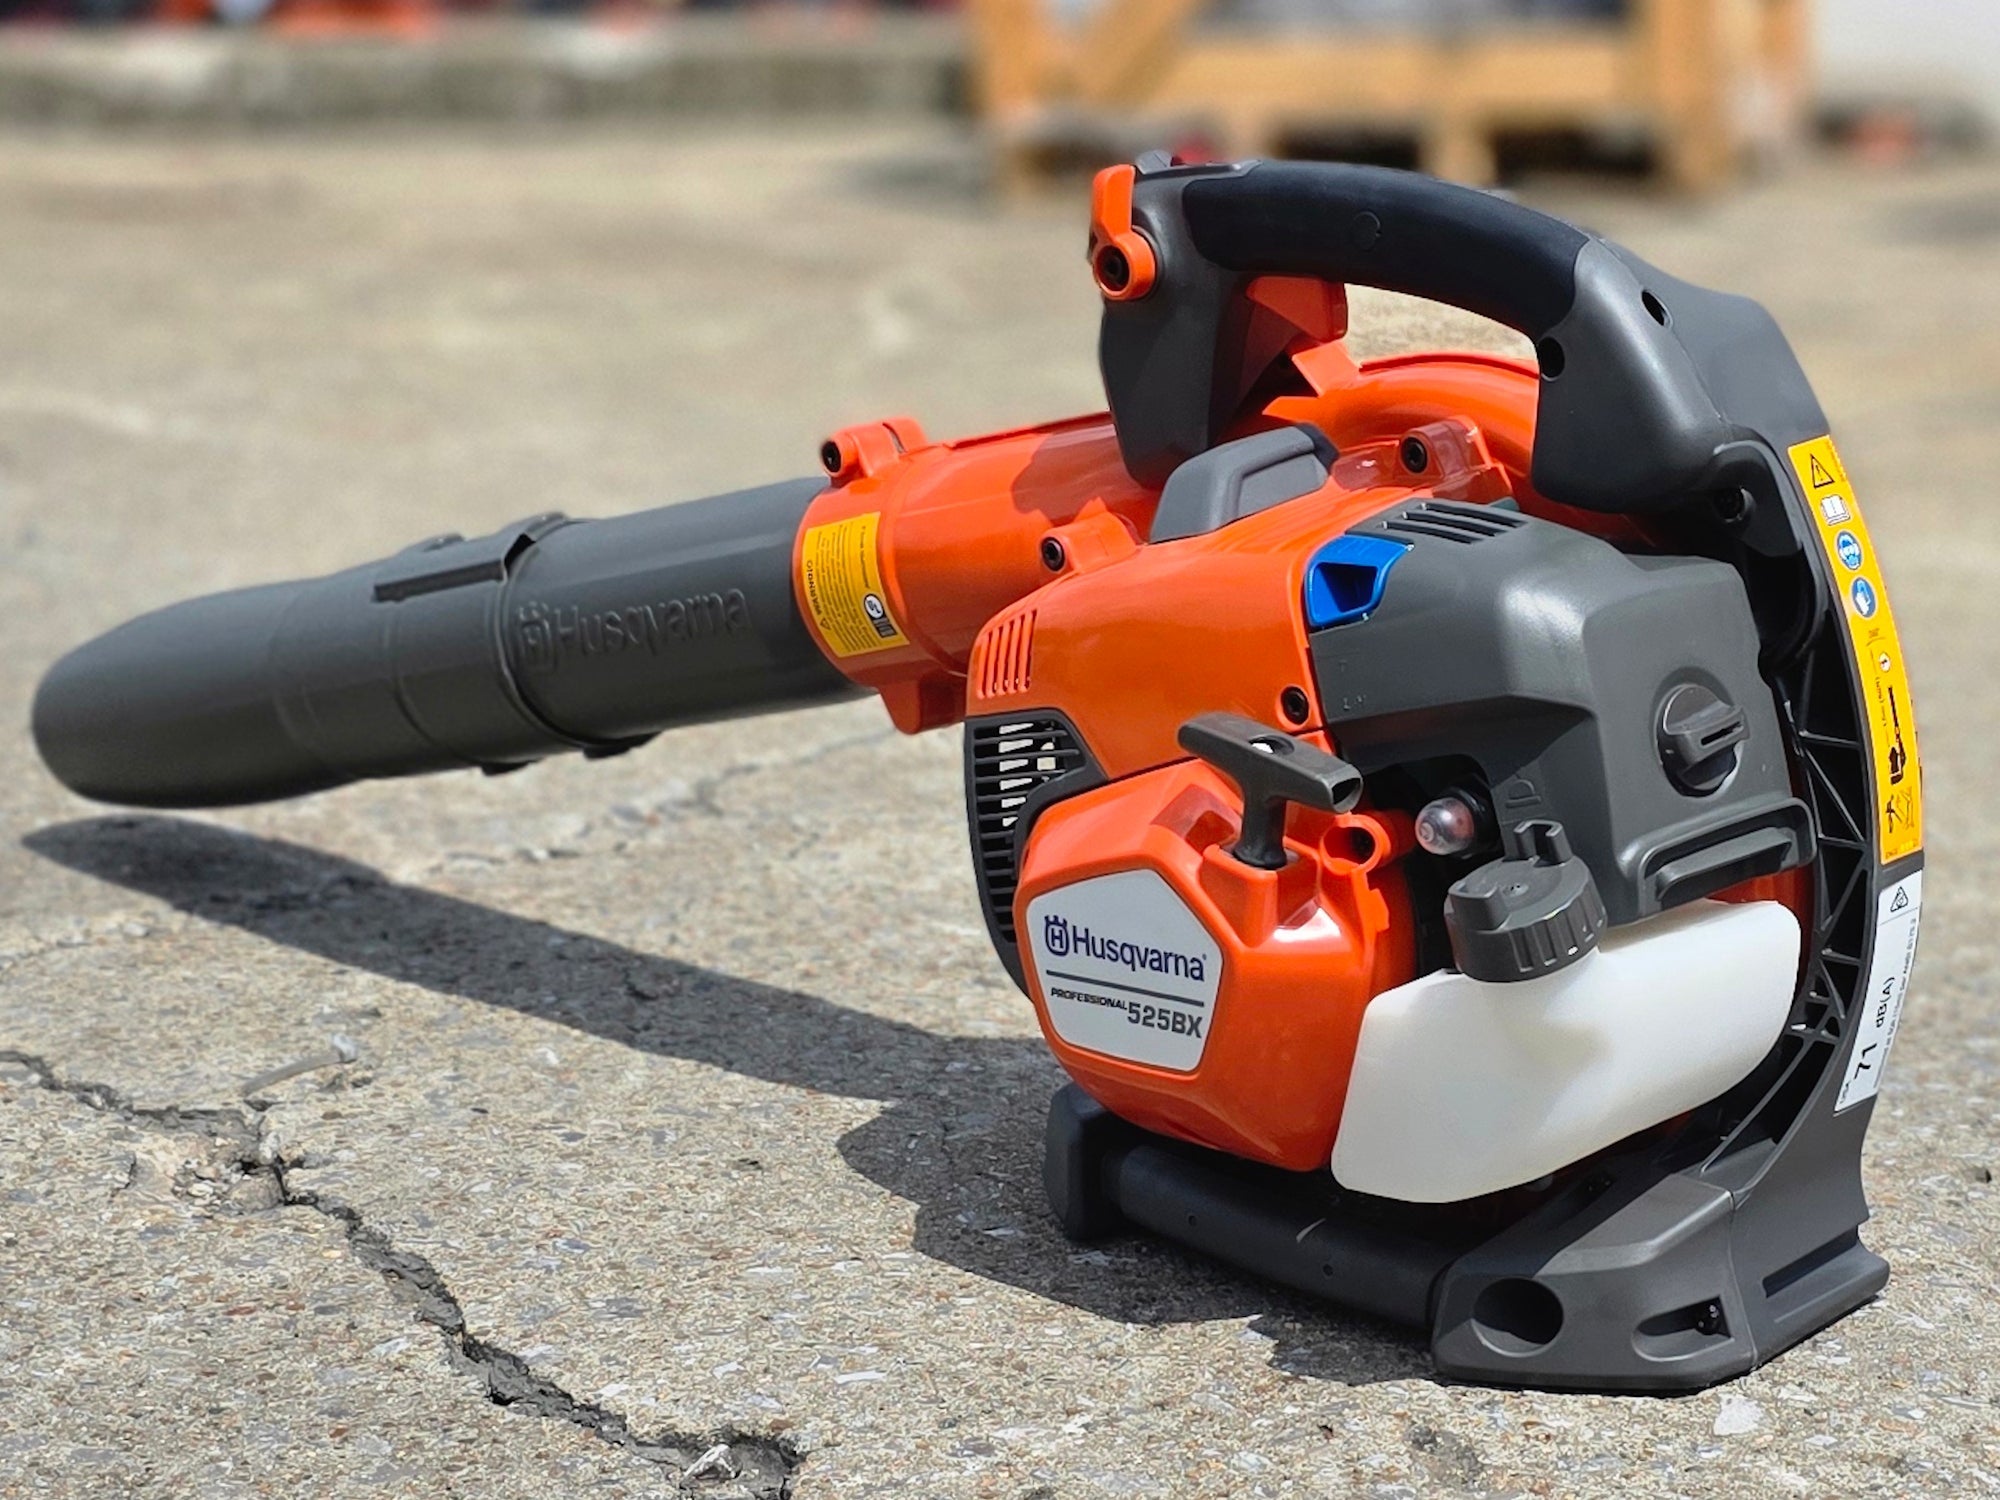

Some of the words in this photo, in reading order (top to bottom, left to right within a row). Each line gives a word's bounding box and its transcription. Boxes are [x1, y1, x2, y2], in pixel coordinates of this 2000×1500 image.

[554, 588, 749, 657] Husqvarna
[1072, 925, 1205, 982] Husqvarna
[1050, 987, 1128, 1011] PROFESSIONAL
[1127, 1002, 1203, 1039] 525BX
[1854, 1042, 1878, 1081] 71
[1876, 976, 1896, 1029] dB(A)
